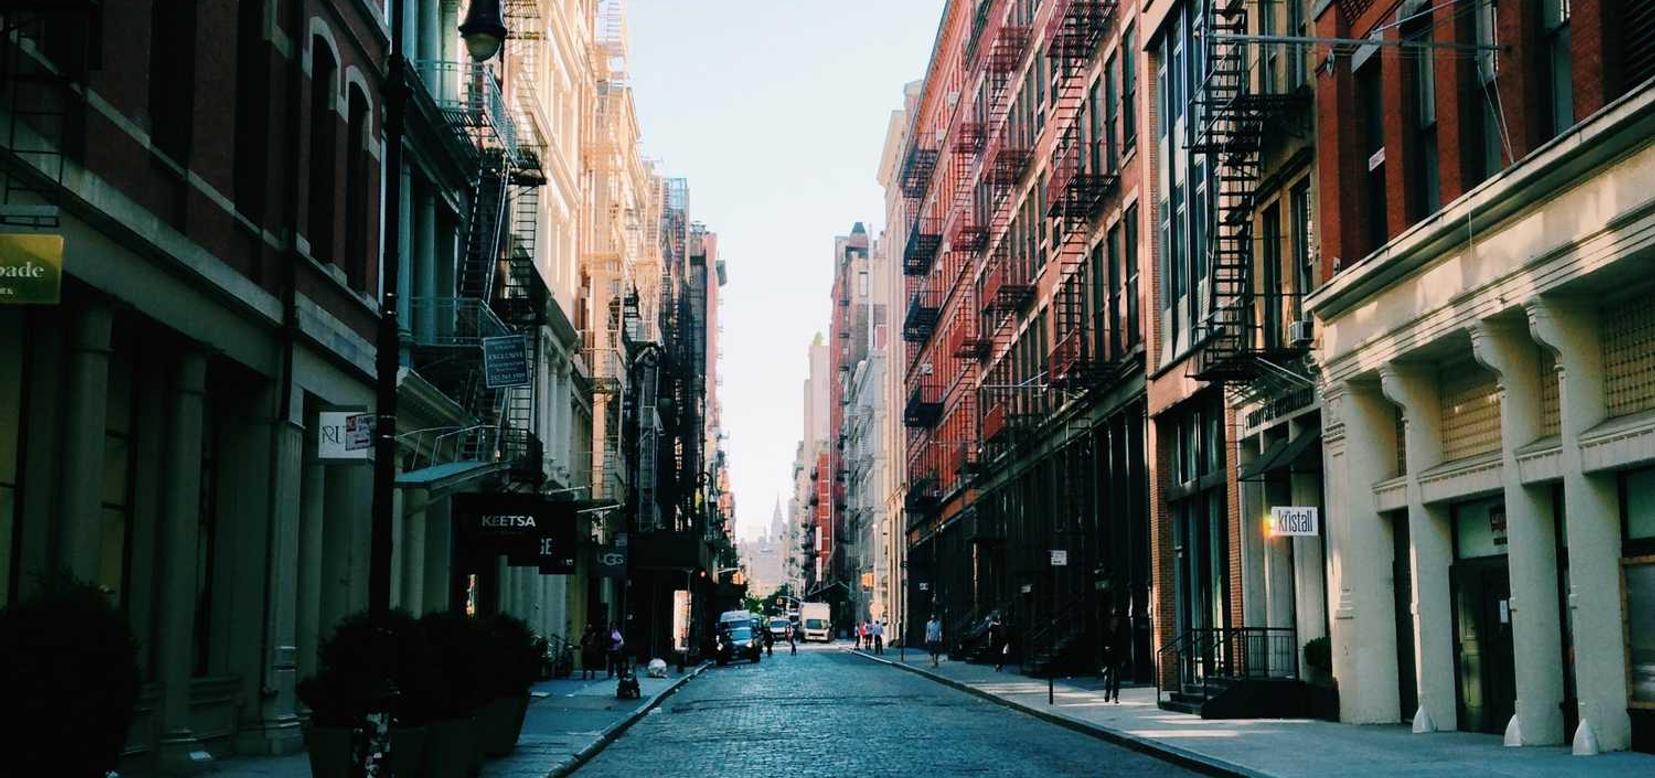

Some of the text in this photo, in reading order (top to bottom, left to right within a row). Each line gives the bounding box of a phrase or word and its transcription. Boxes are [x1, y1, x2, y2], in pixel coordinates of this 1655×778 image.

[322, 425, 346, 444] RU
[482, 515, 537, 527] KEETSA
[1278, 510, 1313, 532] kristall
